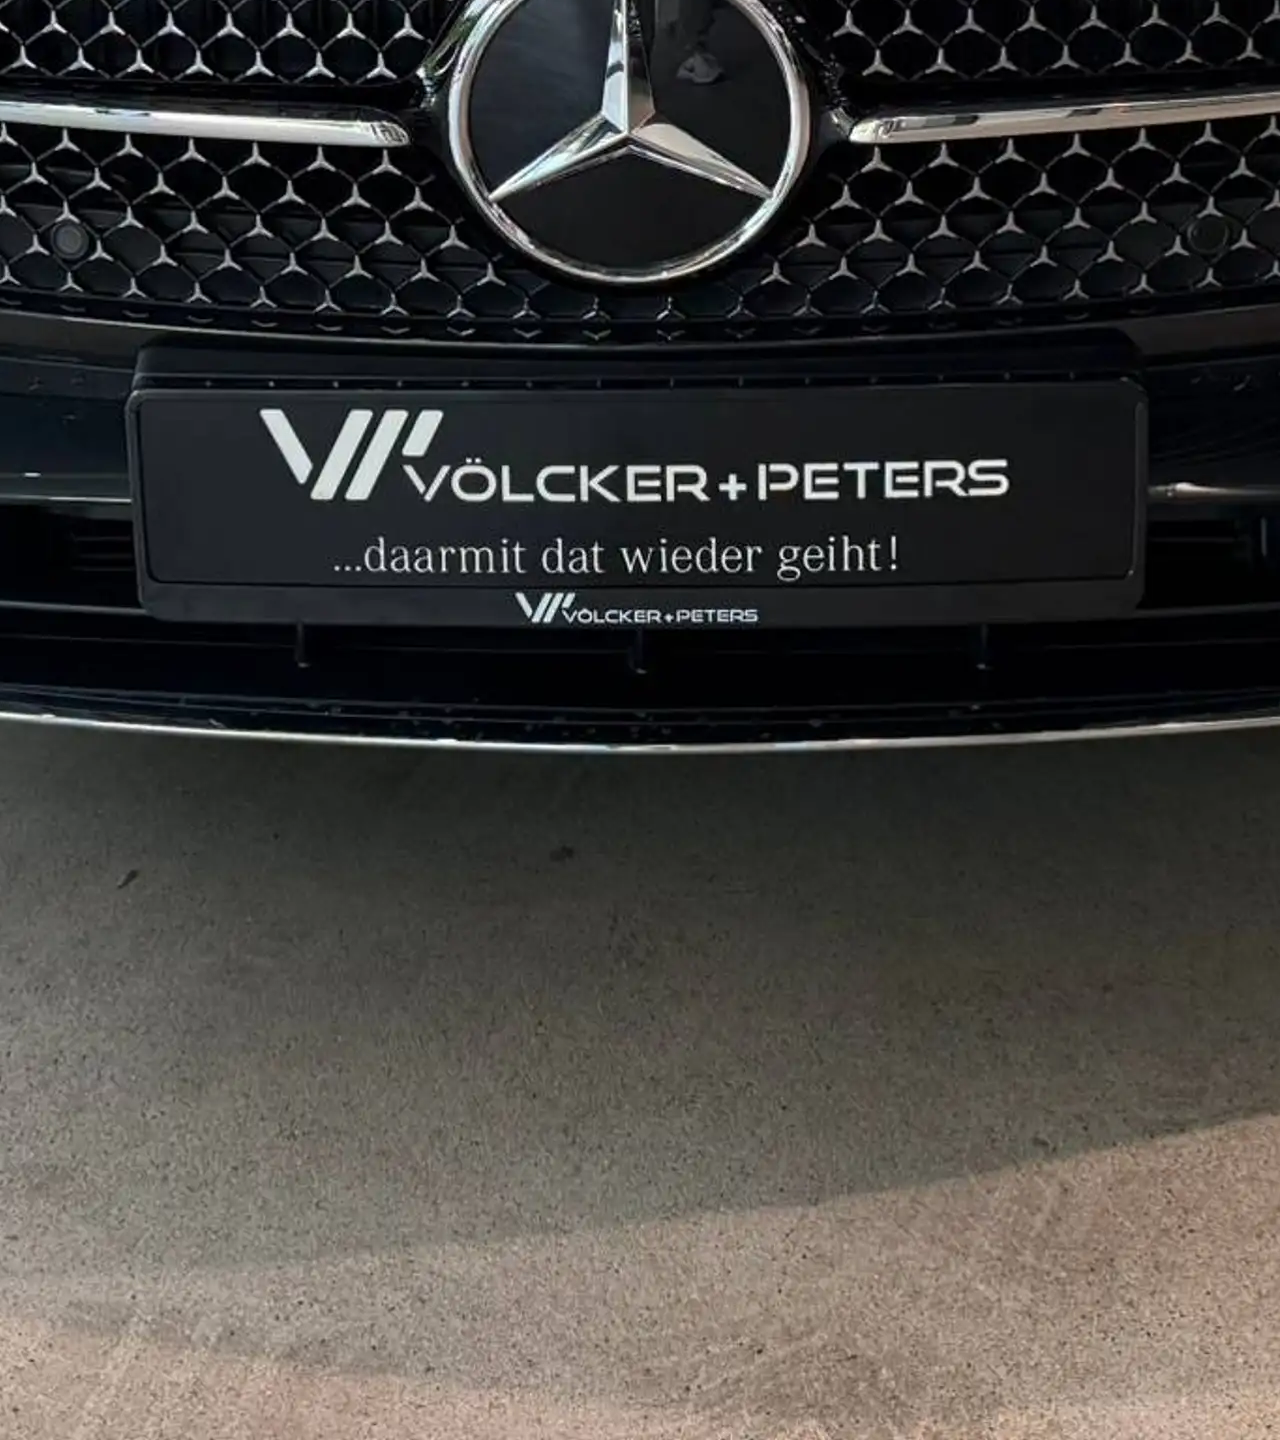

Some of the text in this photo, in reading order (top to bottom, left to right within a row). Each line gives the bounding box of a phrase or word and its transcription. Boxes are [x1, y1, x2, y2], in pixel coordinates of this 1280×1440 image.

[334, 535, 897, 582] ...daarmit dat wieder geiht!
